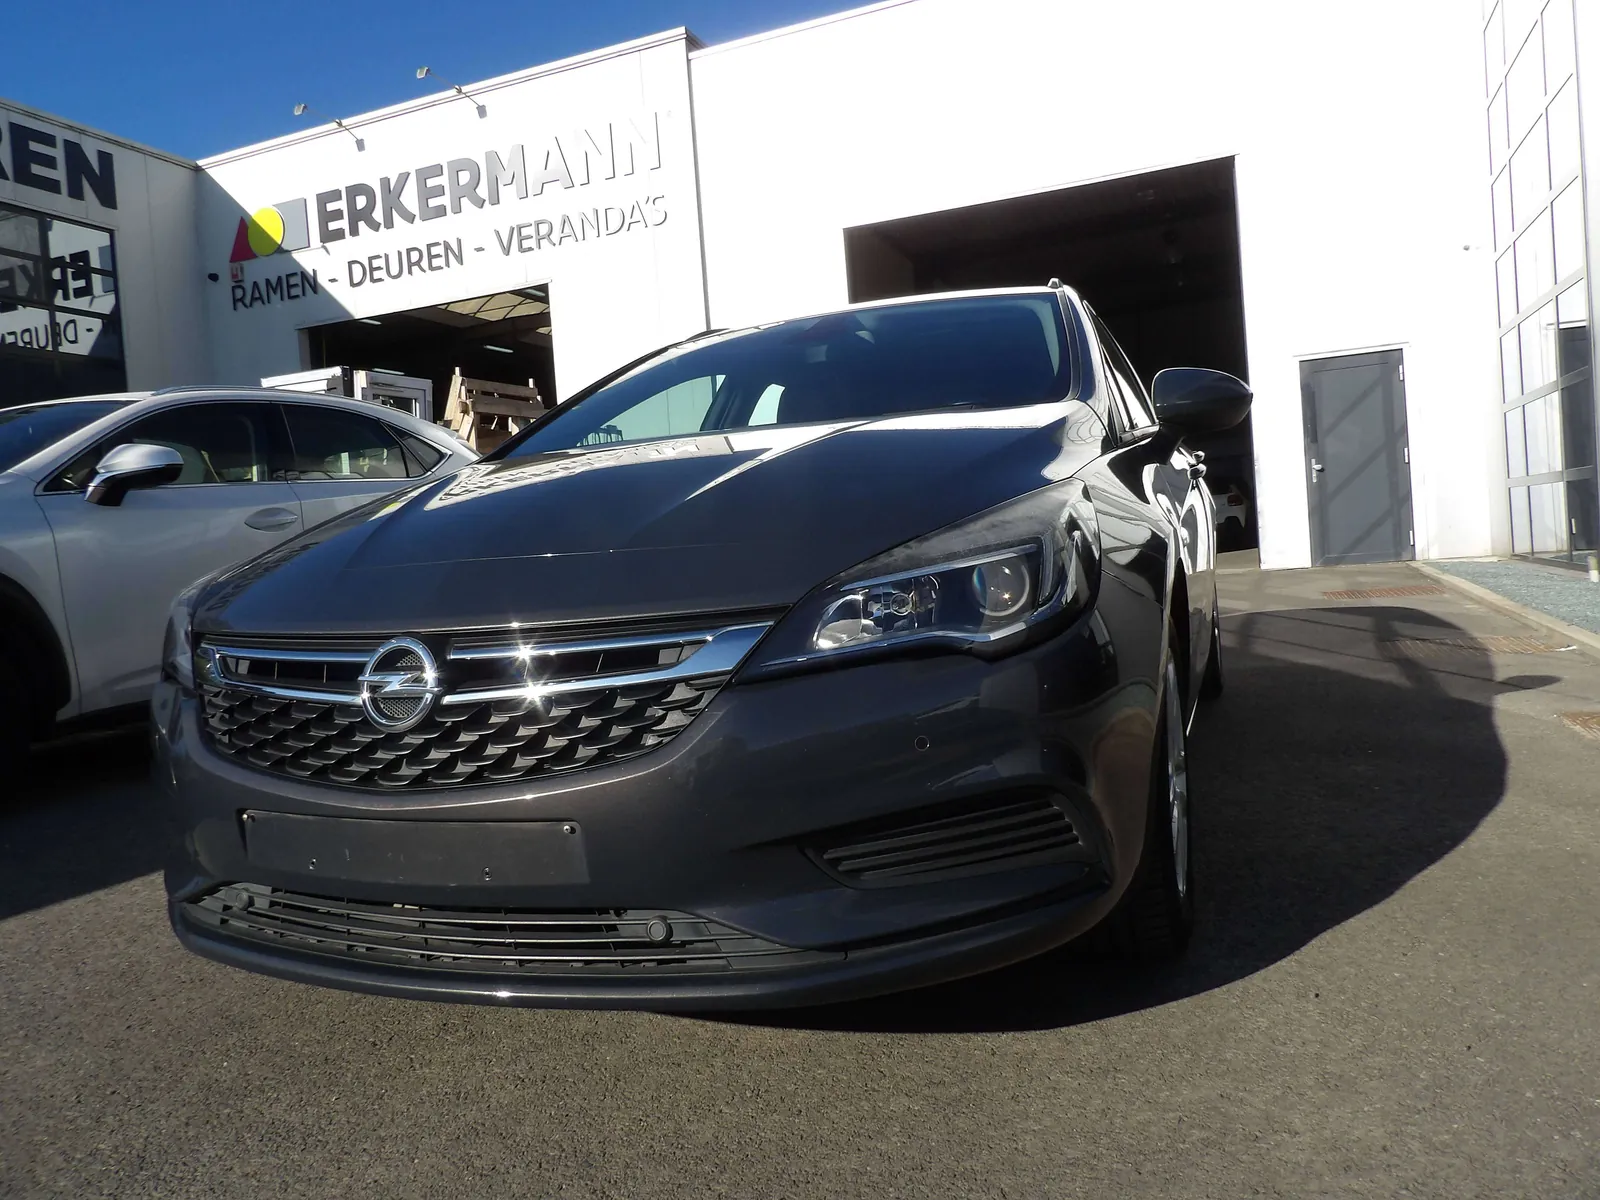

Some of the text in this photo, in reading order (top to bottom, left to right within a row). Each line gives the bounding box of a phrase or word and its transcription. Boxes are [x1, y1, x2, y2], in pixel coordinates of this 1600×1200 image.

[0, 121, 118, 210] EN
[316, 111, 662, 244] ERKERMANN
[231, 268, 319, 312] RAMEN
[347, 237, 464, 288] DEUREN
[493, 194, 669, 257] VERANDA'S
